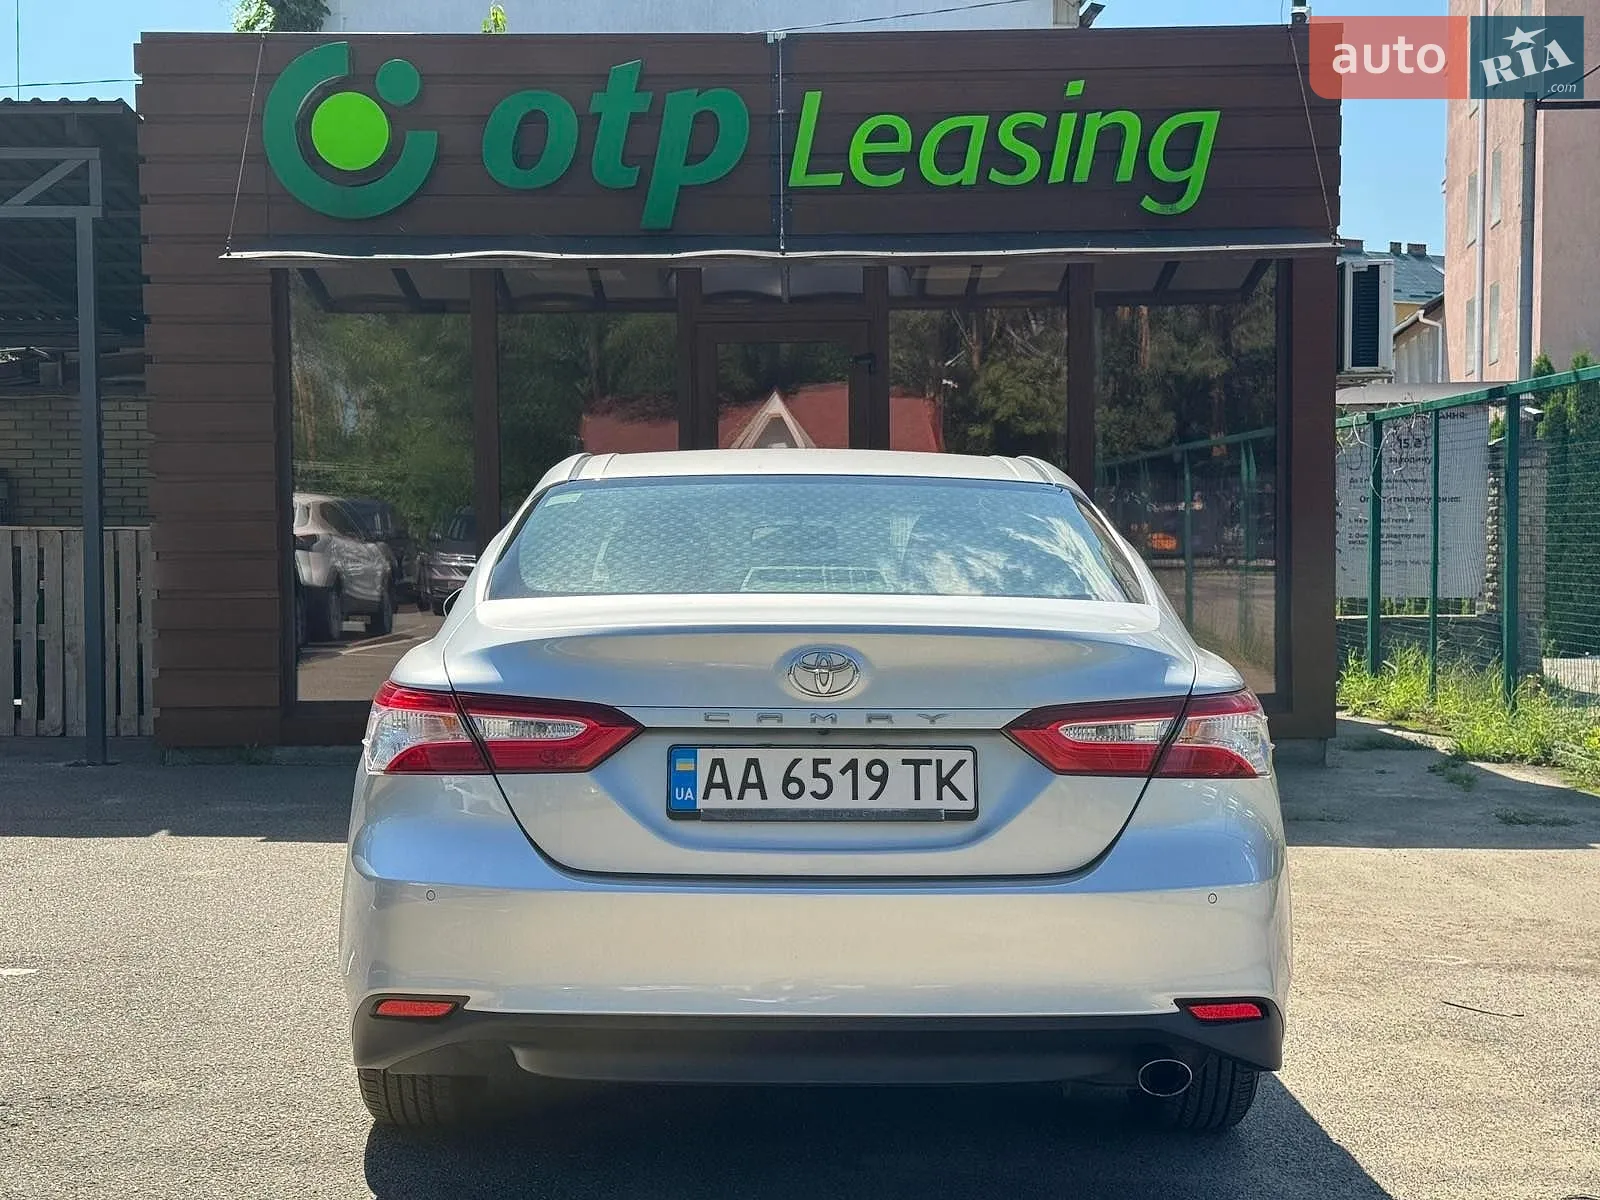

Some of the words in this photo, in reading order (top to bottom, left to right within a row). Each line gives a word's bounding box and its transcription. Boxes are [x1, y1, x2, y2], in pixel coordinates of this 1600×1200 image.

[482, 60, 750, 229] otp
[788, 80, 1221, 215] Leasing
[704, 712, 951, 724] CAMRY
[702, 757, 768, 801] AA
[781, 757, 890, 801] 6519
[901, 758, 968, 802] TK
[675, 788, 694, 801] UA
